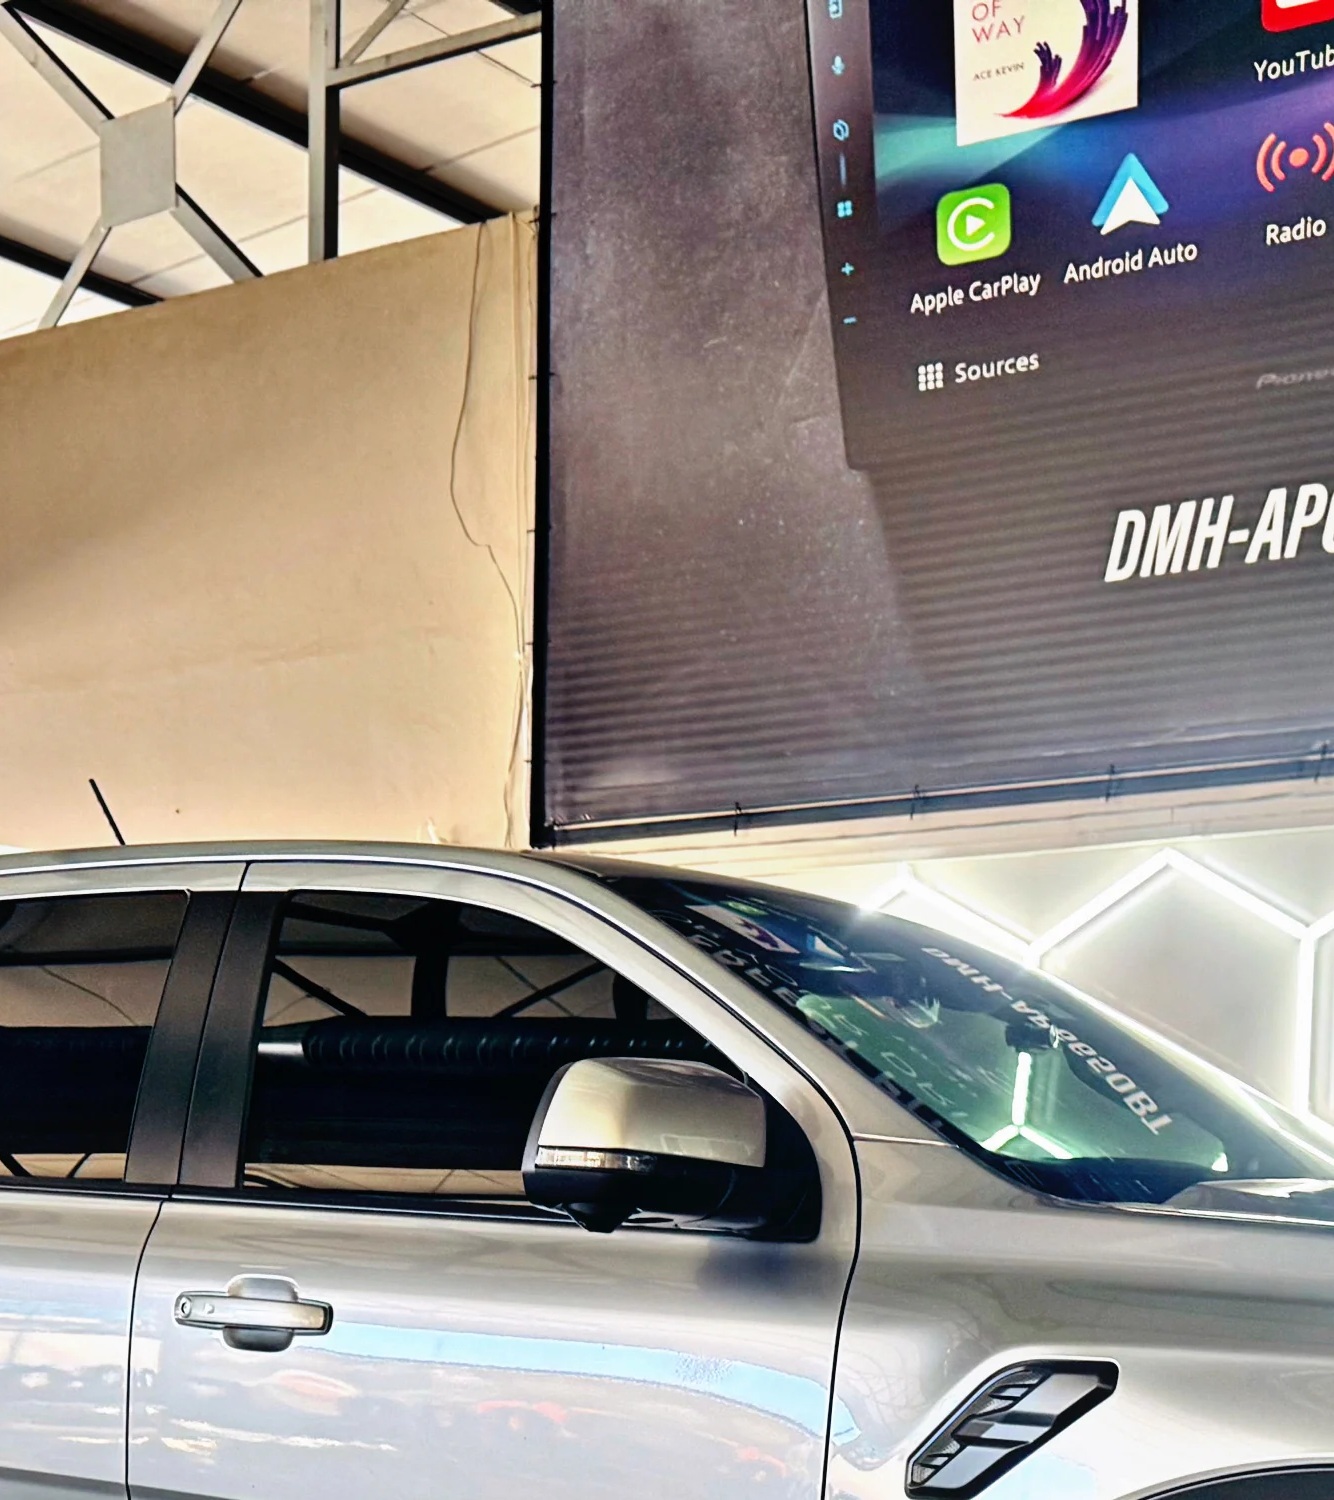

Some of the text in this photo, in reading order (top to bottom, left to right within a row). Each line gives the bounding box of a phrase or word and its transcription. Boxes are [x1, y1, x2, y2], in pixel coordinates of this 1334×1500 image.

[972, 0, 1002, 22] OF
[972, 15, 1025, 43] WAY
[973, 61, 1025, 82] ACE KEVIN
[1265, 215, 1327, 246] Radio
[1063, 242, 1198, 285] Android Auto
[910, 271, 1042, 317] Apple CarPlay
[954, 353, 1040, 384] Sources
